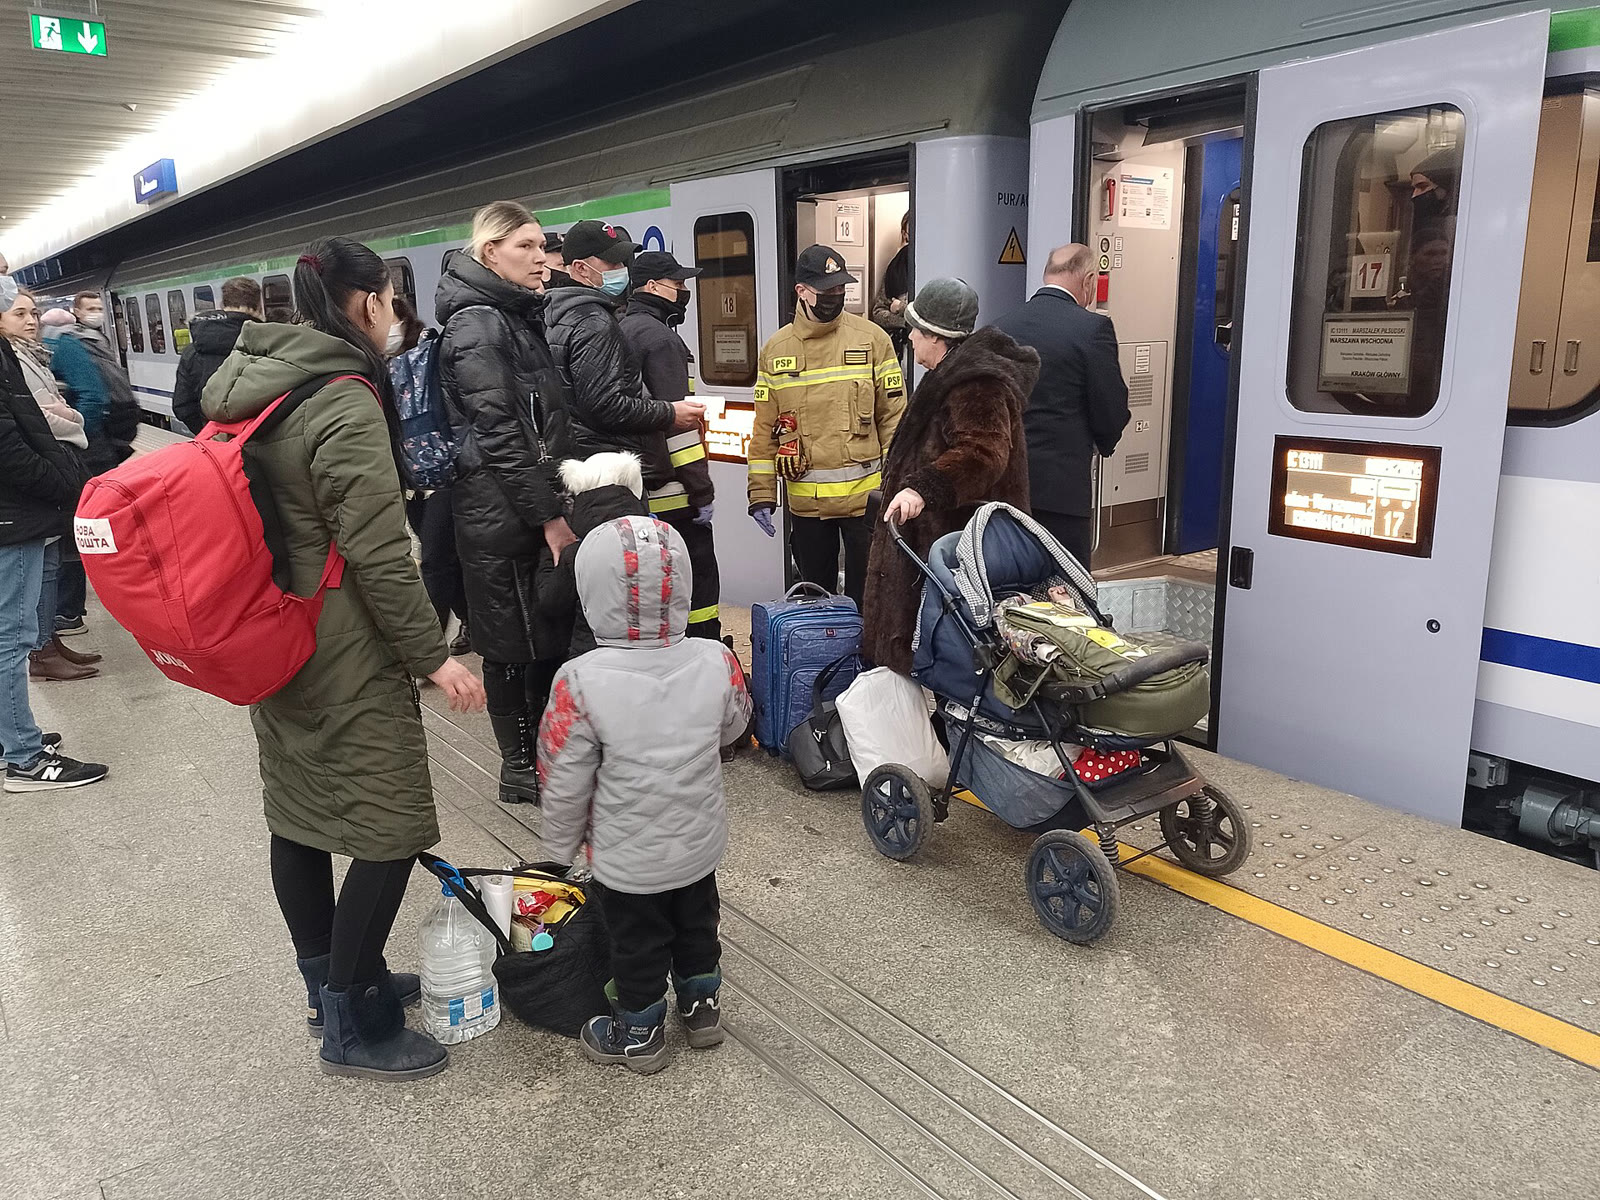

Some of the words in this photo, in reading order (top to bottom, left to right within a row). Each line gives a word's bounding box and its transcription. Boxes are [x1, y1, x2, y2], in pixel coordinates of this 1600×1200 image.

[840, 221, 850, 237] 18
[1358, 262, 1383, 289] 17
[724, 297, 734, 313] 18
[775, 358, 793, 369] PSP
[887, 375, 901, 387] PSP
[1351, 370, 1376, 378] KRAKÓW
[1383, 510, 1405, 537] 17
[40, 766, 64, 780] N
